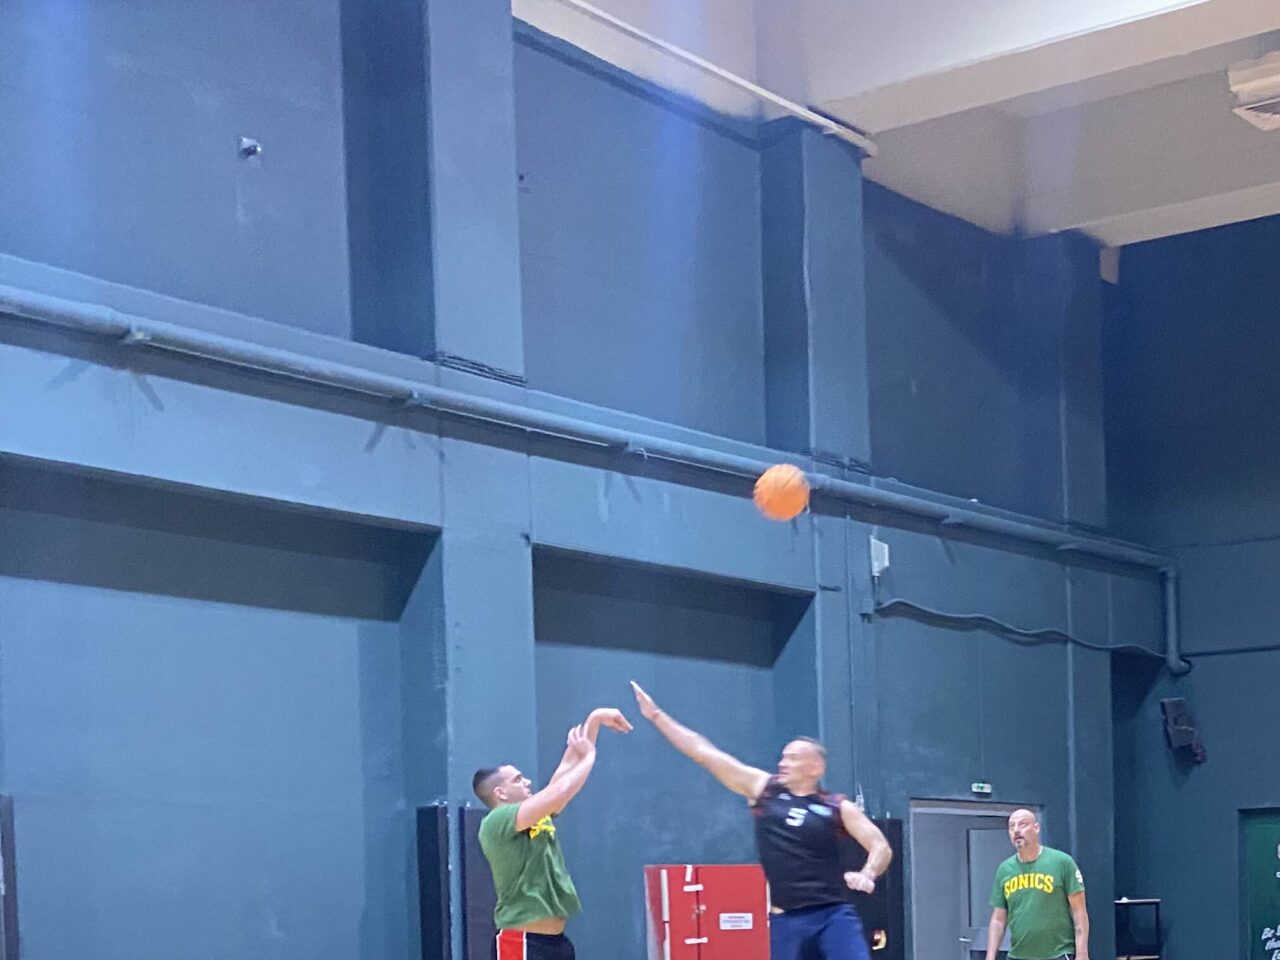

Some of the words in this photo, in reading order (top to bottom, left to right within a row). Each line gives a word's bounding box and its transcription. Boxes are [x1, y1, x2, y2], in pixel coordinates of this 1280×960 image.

[785, 807, 808, 827] 5
[1004, 873, 1054, 899] SONICS
[1261, 927, 1274, 940] Be
